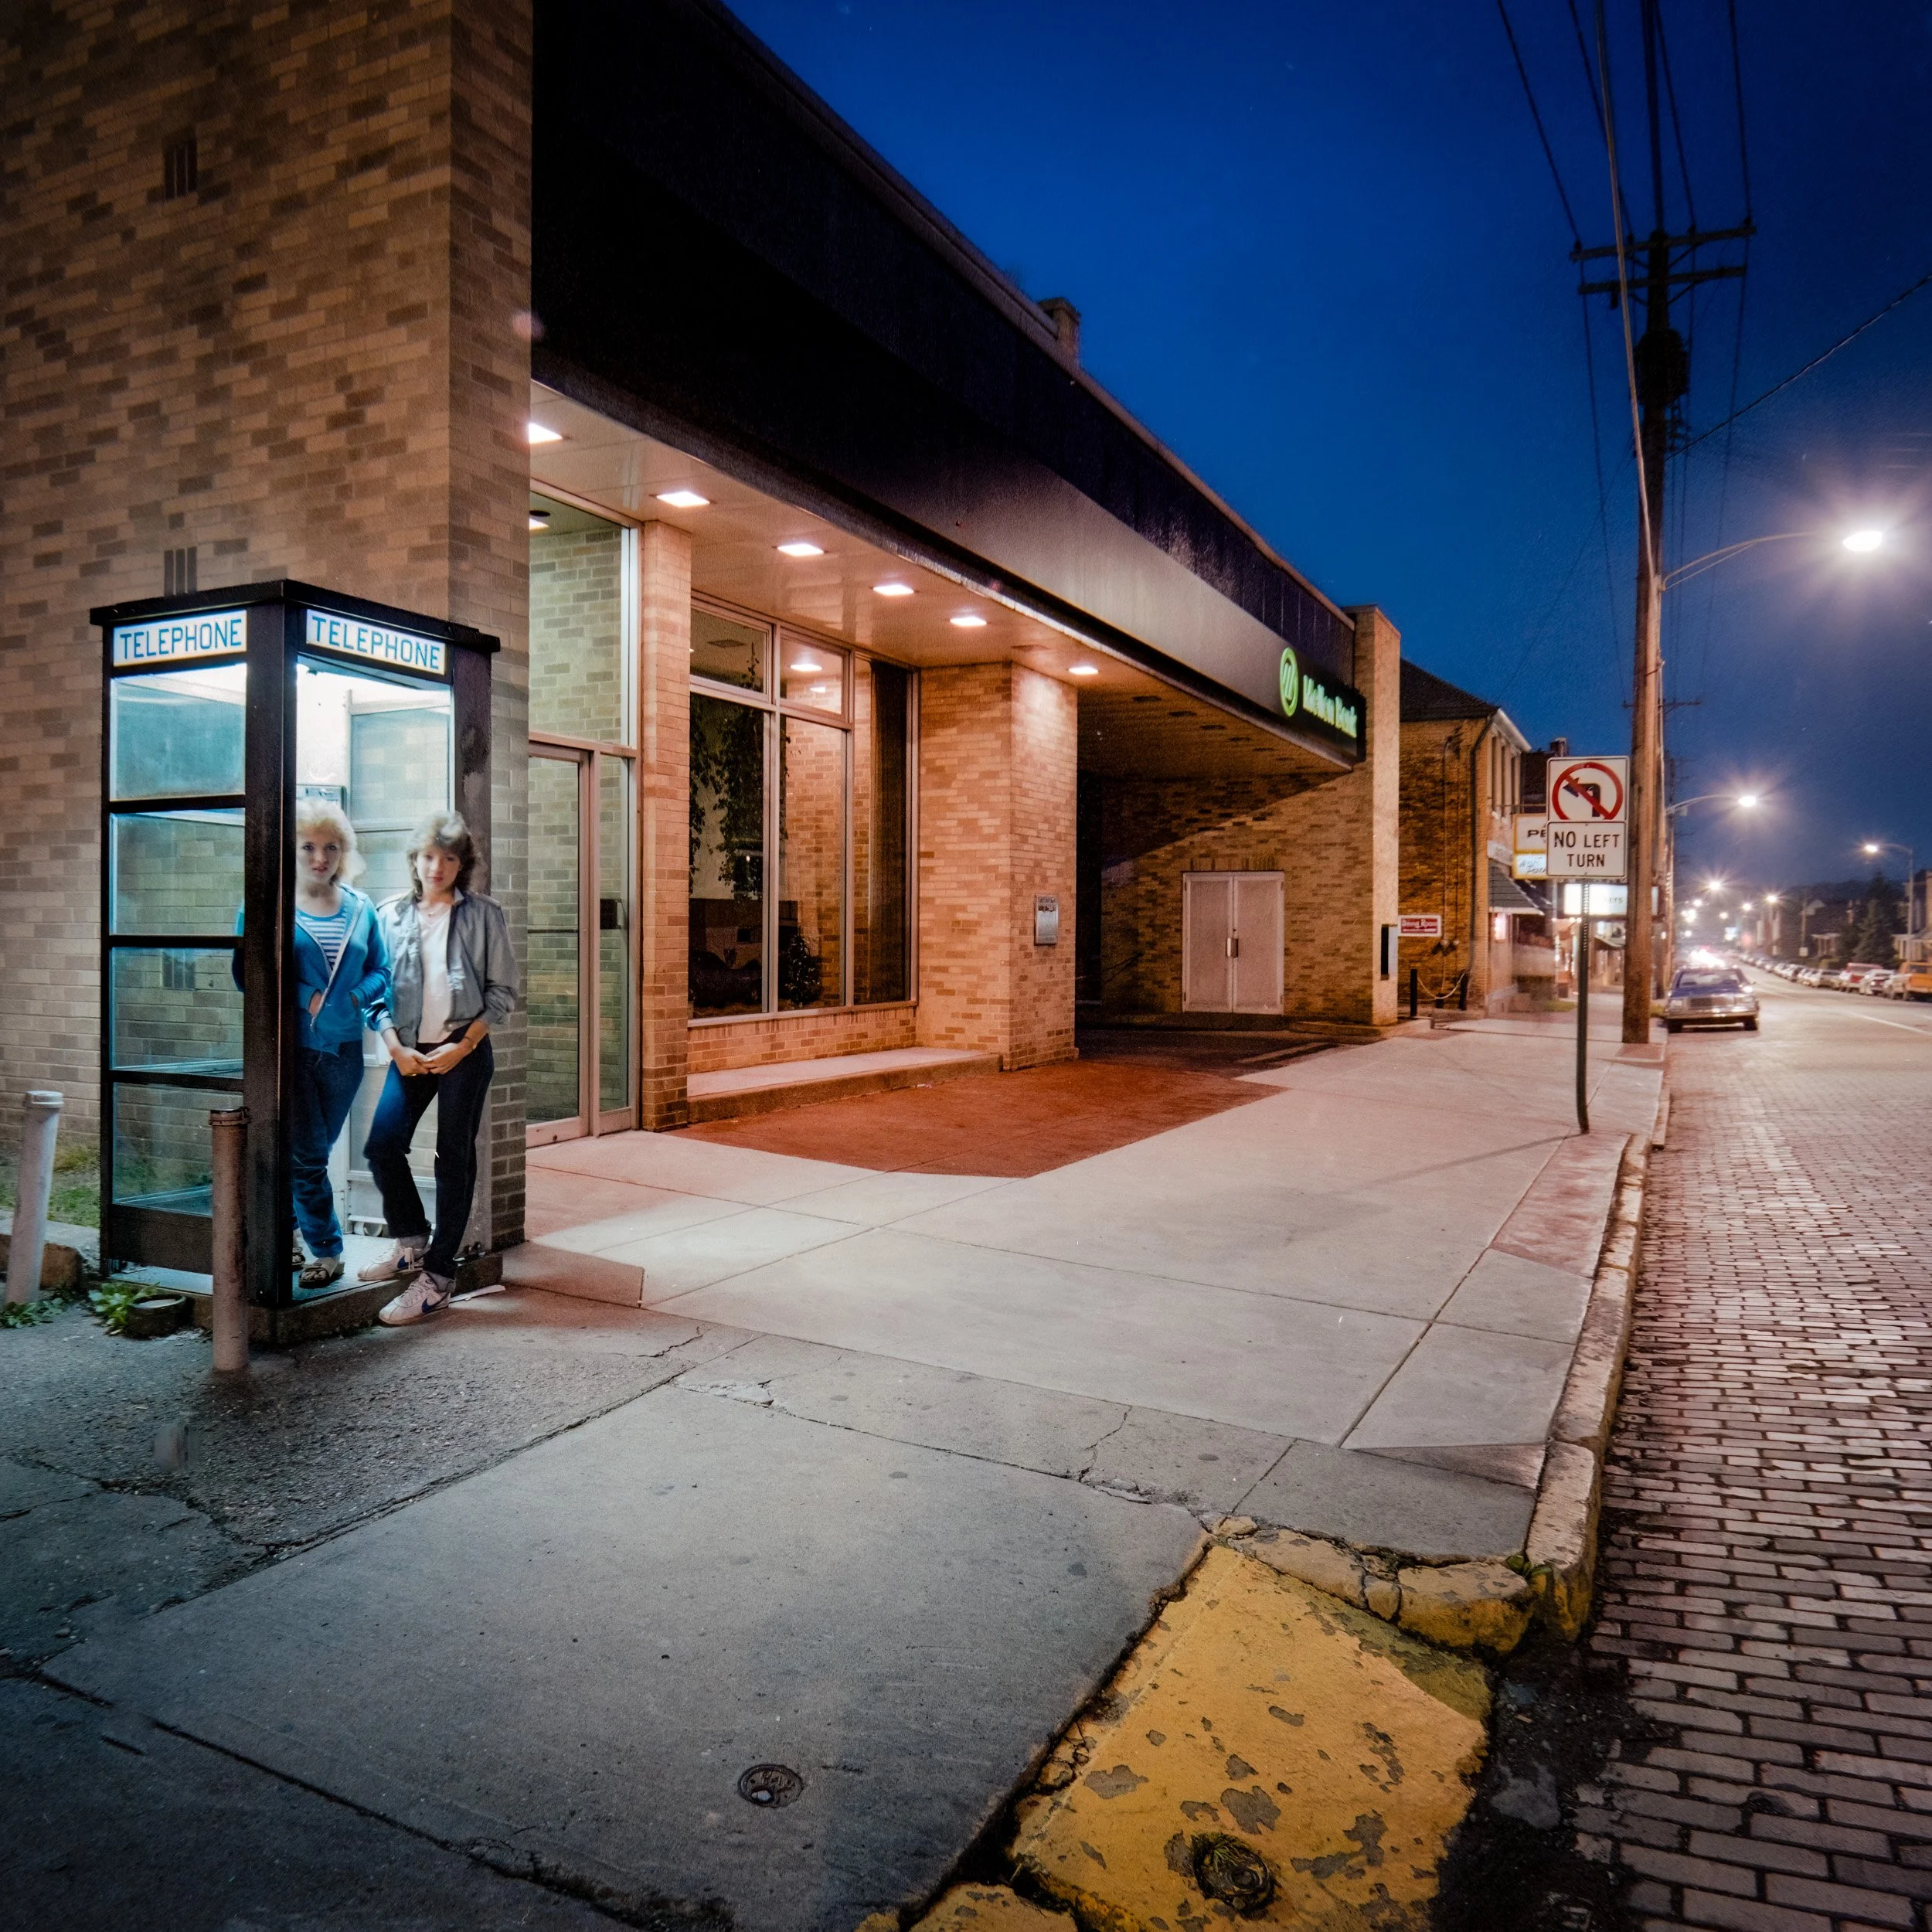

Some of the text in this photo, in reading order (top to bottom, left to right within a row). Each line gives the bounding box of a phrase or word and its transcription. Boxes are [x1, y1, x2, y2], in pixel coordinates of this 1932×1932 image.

[119, 617, 243, 659] TELEPHONE
[311, 616, 441, 670] TELEPHONE
[1553, 831, 1620, 849] NO LEFT
[1566, 853, 1605, 867] TURN
